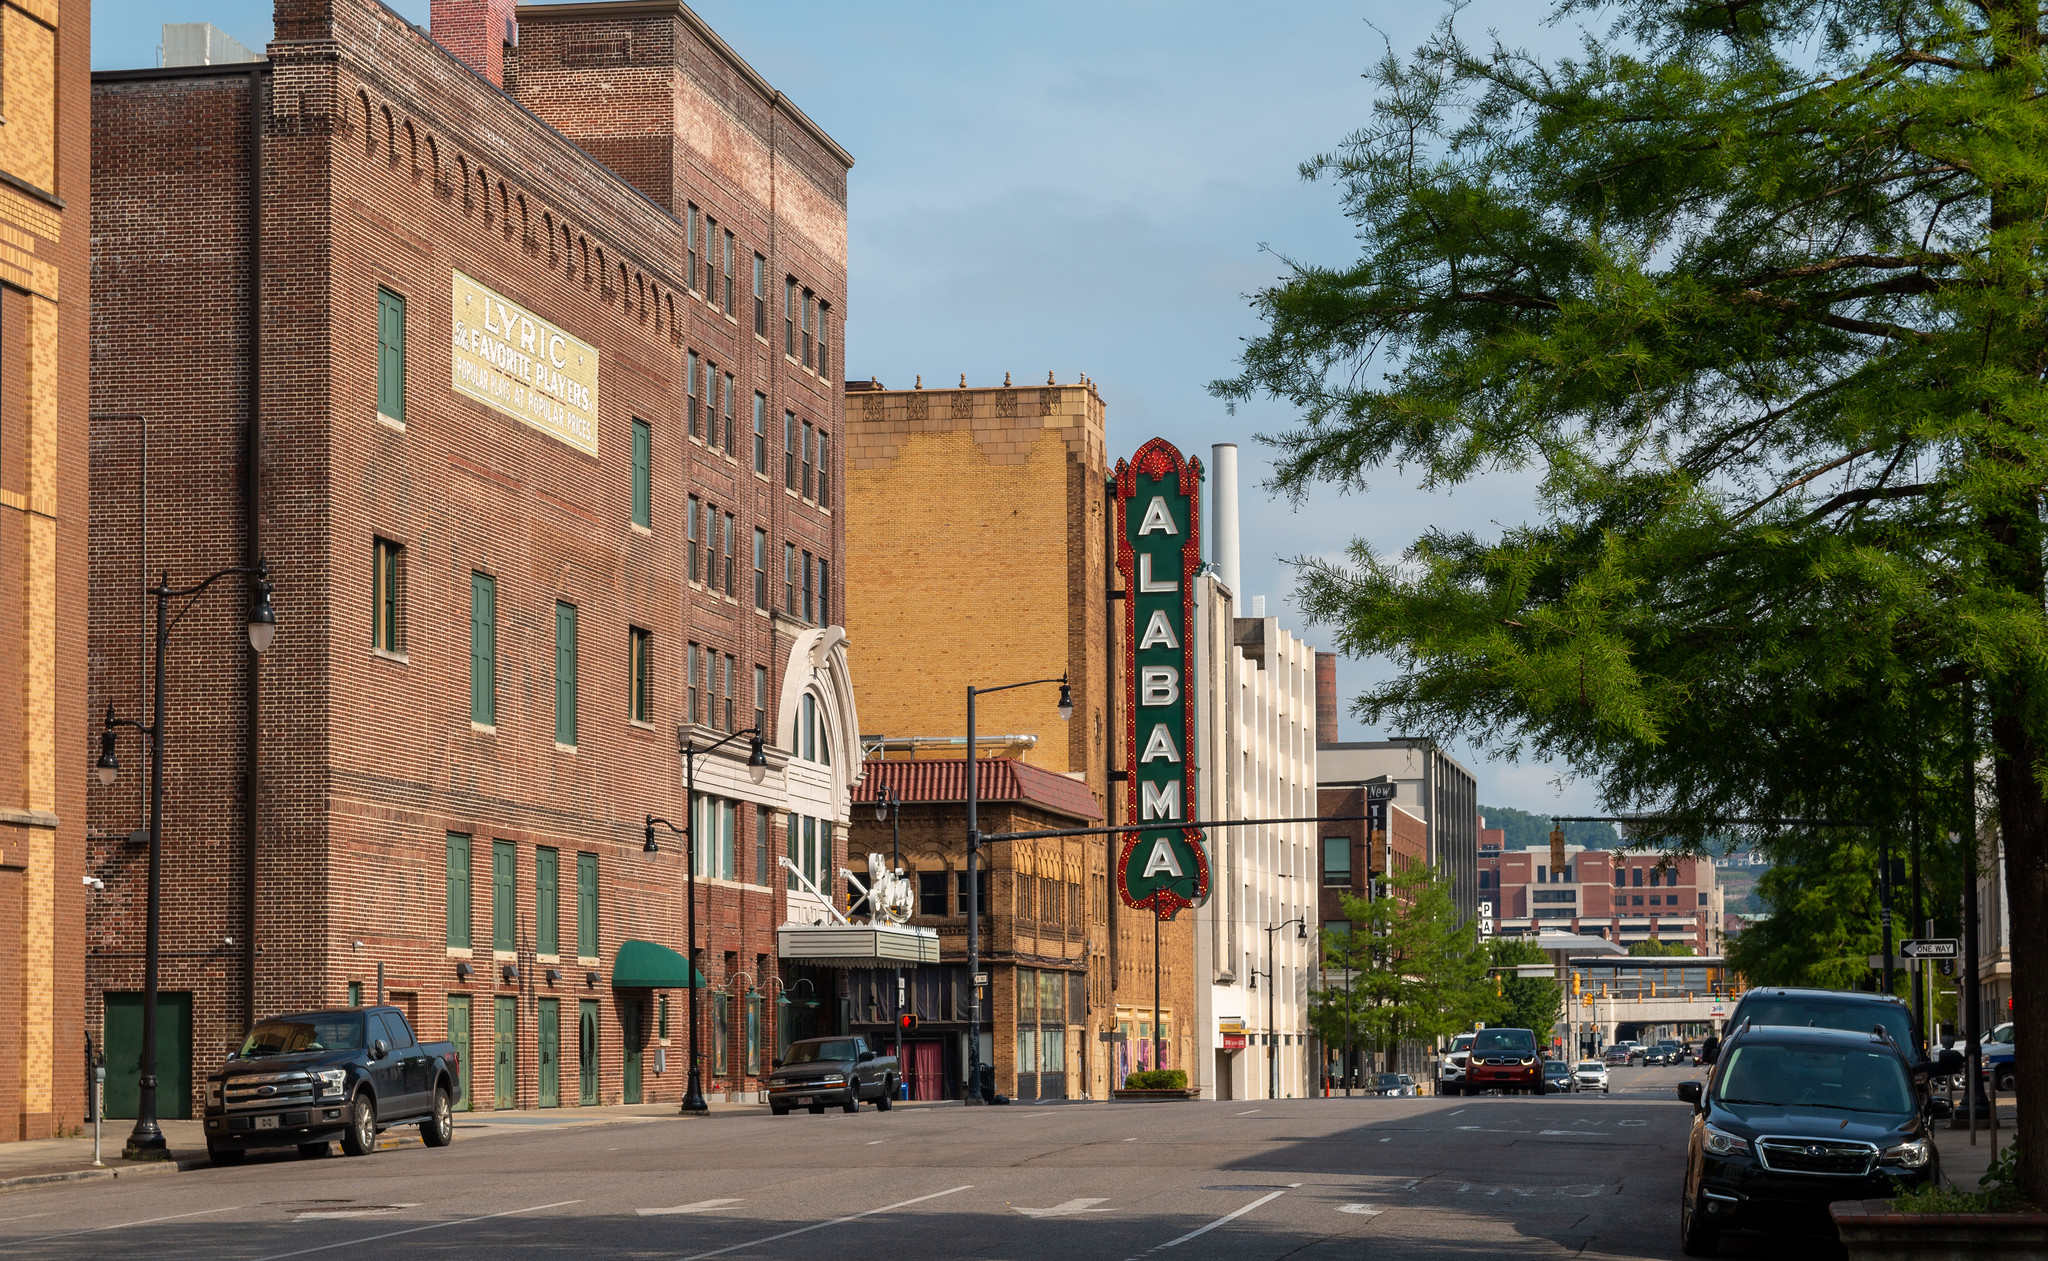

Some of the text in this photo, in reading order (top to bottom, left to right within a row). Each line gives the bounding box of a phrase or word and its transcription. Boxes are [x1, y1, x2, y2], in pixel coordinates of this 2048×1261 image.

[454, 320, 470, 352] The
[471, 328, 531, 381] FAVORITE
[484, 296, 566, 369] LYRIC
[457, 355, 488, 391] POPULAR
[491, 373, 511, 401] PLAYS
[514, 386, 525, 409] AT
[528, 391, 564, 429] POPULAR
[1138, 495, 1184, 878] ALABAMA
[1369, 785, 1390, 799] New
[1917, 945, 1951, 953] ONE WAY
